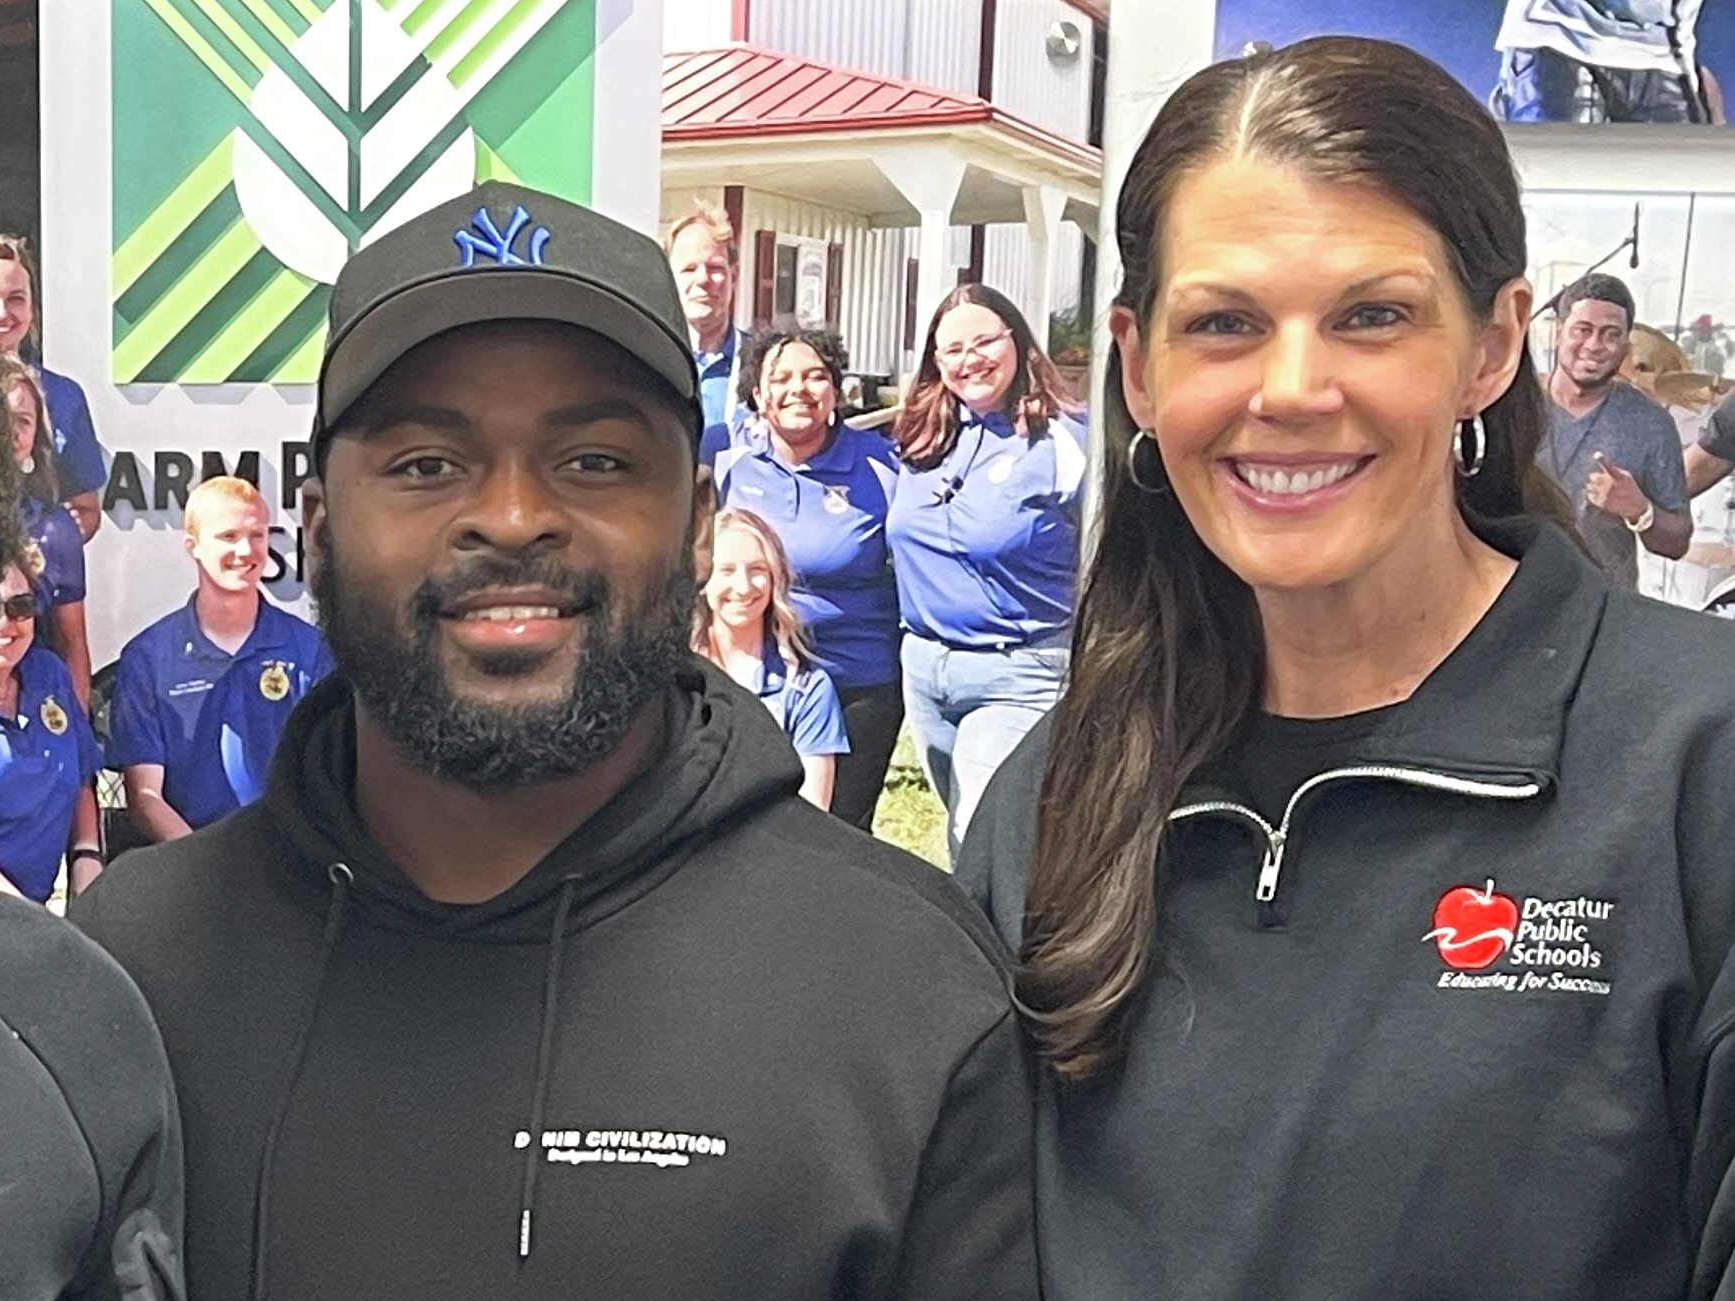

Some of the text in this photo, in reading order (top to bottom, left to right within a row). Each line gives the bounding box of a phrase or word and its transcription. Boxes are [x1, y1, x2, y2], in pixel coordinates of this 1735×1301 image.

[102, 451, 260, 511] ARM
[1522, 897, 1614, 919] Decatur
[1517, 918, 1589, 942] Public
[1509, 941, 1602, 968] Schools
[1517, 970, 1549, 992] for
[585, 1131, 727, 1156] CIVILIZATION
